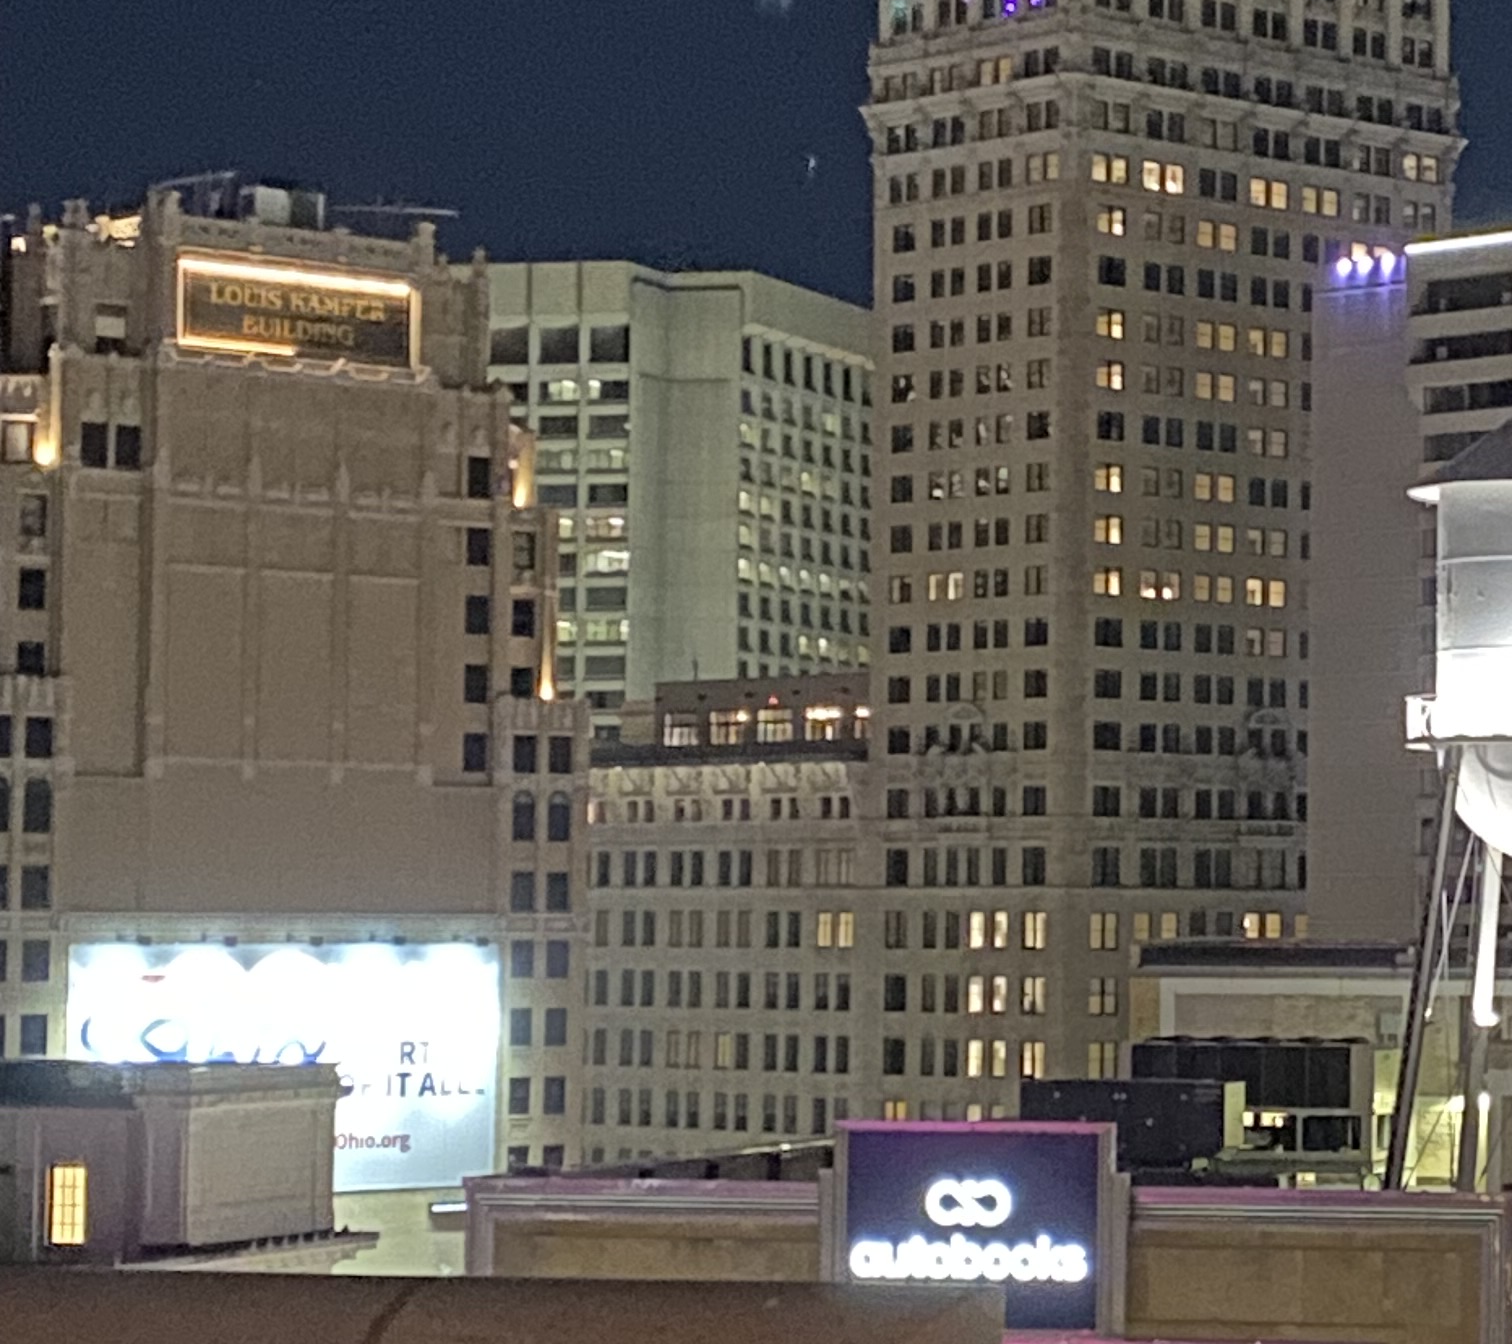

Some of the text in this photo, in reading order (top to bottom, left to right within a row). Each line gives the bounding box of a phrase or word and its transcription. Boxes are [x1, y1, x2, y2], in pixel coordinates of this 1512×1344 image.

[209, 281, 283, 310] LOUIS
[242, 314, 355, 346] BUILDING
[849, 1232, 1089, 1283] autobooks
